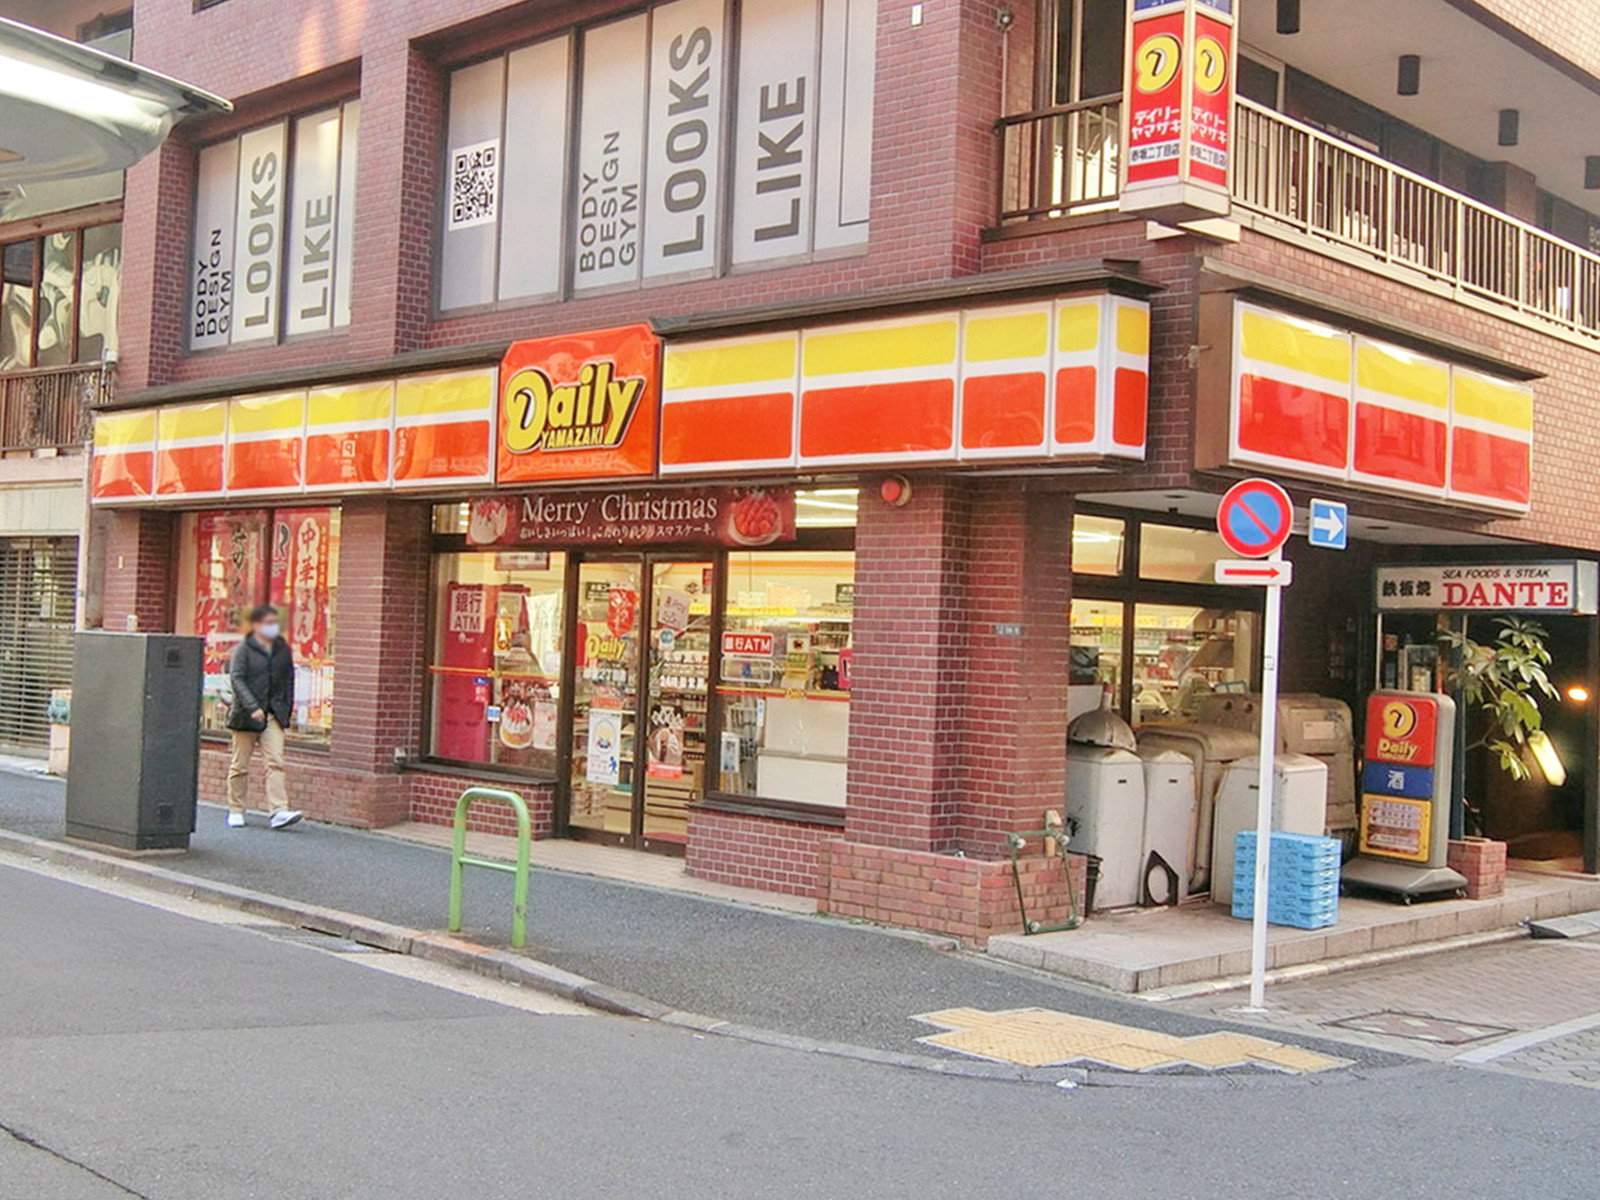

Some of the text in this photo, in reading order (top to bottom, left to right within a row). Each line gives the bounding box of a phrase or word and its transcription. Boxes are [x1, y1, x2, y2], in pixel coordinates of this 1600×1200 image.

[1134, 106, 1180, 125] デイリー
[663, 26, 712, 257] LOOKS
[754, 76, 805, 242] LIKE
[579, 172, 598, 273] BODY
[600, 131, 620, 269] DESIGN
[245, 152, 277, 327] LOOKS
[619, 184, 638, 266] GYM
[301, 195, 332, 320] LIKE
[195, 260, 208, 338] BODY
[207, 229, 222, 335] DESIGN
[219, 271, 232, 333] GYM
[505, 361, 645, 451] Daily
[541, 427, 605, 450] YAMAZAKI
[521, 491, 718, 525] Merry Christmas
[1382, 579, 1432, 598] 鉄板焼
[1441, 582, 1569, 607] DANTE
[1442, 569, 1461, 579] SEA
[1465, 569, 1501, 579] FOODS
[1515, 568, 1551, 578] STEAK
[454, 615, 480, 630] ATM
[456, 592, 482, 613] 銀行
[586, 633, 627, 660] Daily
[1378, 738, 1419, 761] Daily
[1387, 769, 1405, 791] 酒
